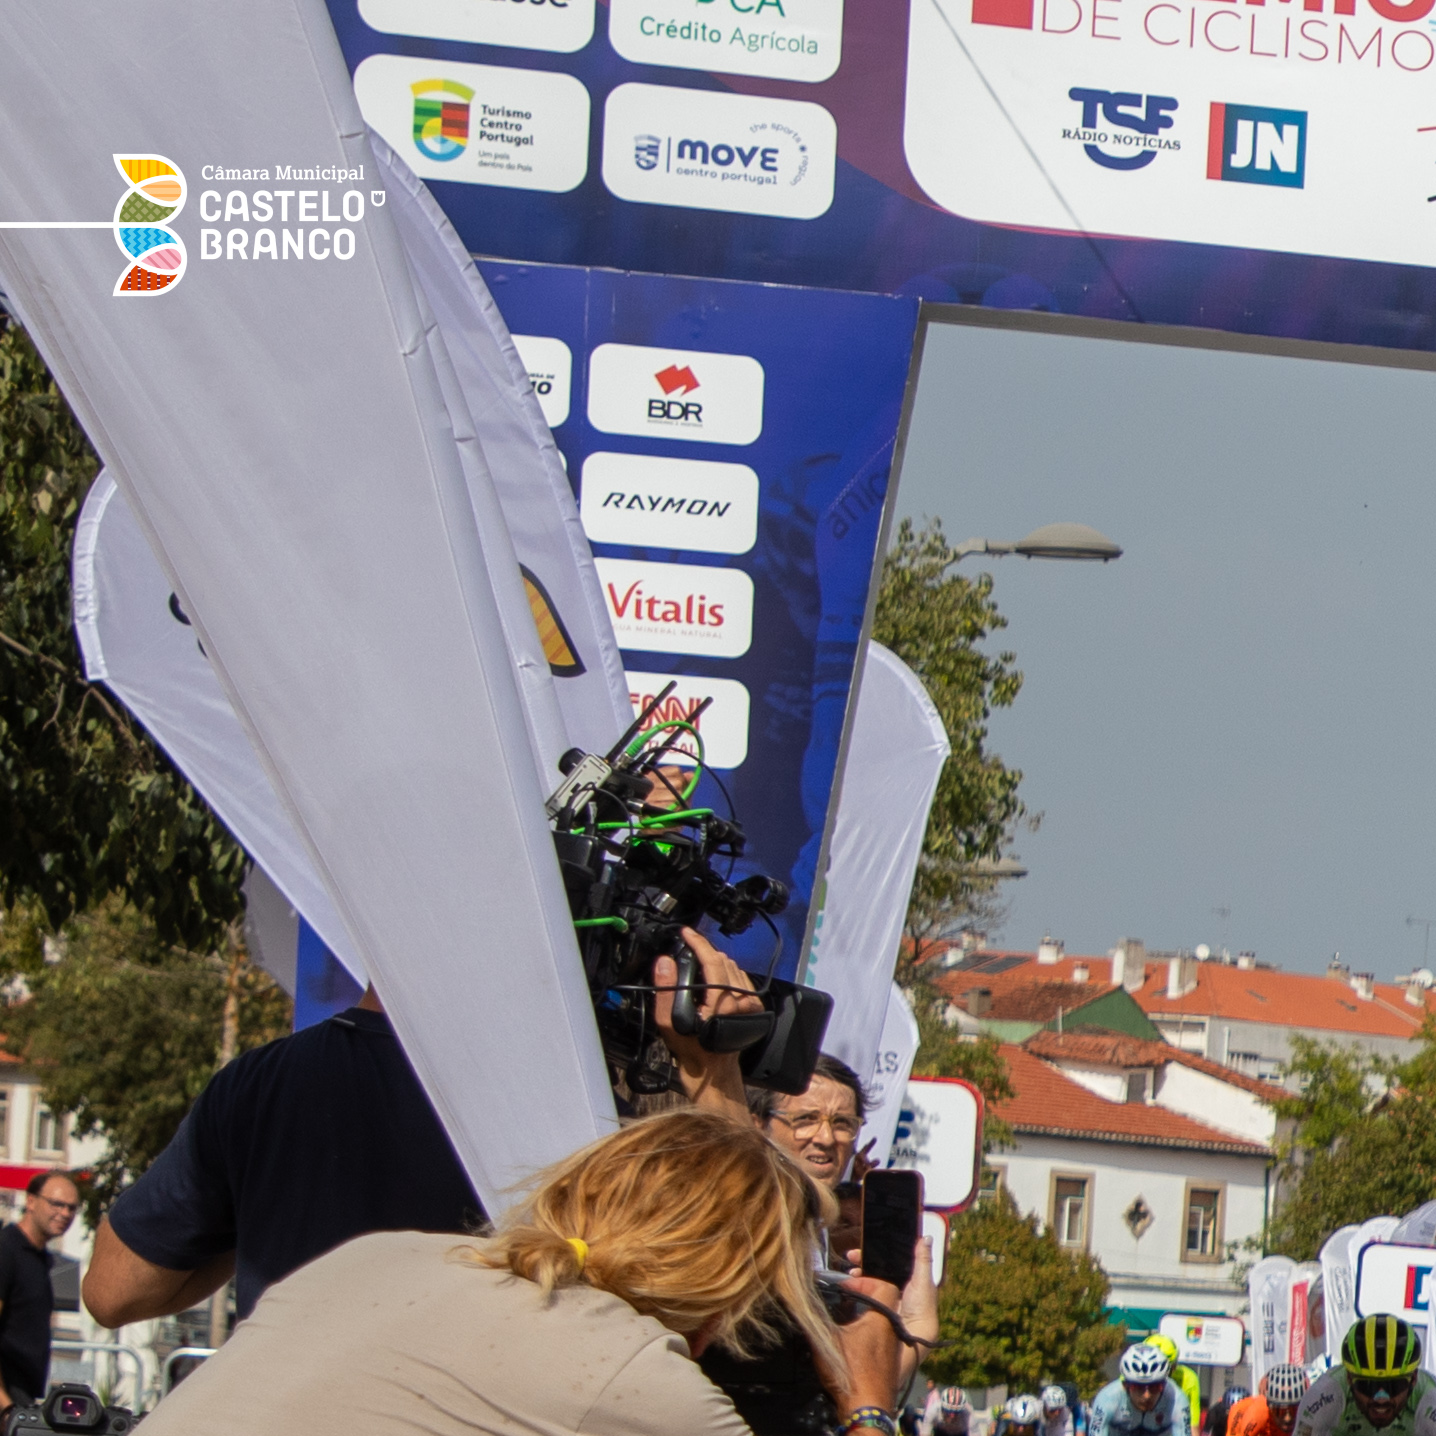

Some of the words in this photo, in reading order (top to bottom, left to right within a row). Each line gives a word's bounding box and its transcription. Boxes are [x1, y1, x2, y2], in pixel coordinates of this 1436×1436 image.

[639, 16, 722, 43] Crédito
[729, 26, 819, 55] Agrícola
[1041, 0, 1121, 41] DE
[1143, 4, 1435, 71] CICLISMO
[481, 104, 532, 120] Turismo
[1068, 87, 1179, 135] TSF
[480, 118, 523, 132] Centro
[749, 123, 767, 133] the
[770, 122, 802, 145] sports
[479, 130, 534, 147] Portugal
[1061, 127, 1109, 146] RÁDIO
[1112, 133, 1182, 151] NOTÍCIAS
[1230, 118, 1300, 173] JN
[676, 166, 718, 179] centro
[721, 171, 778, 186] portugal
[647, 399, 703, 423] BDR
[602, 491, 732, 518] RAYMON
[607, 579, 725, 628] Vitalis
[611, 620, 632, 633] GUA
[635, 624, 677, 637] MINERAL
[680, 628, 724, 640] NATURAL
